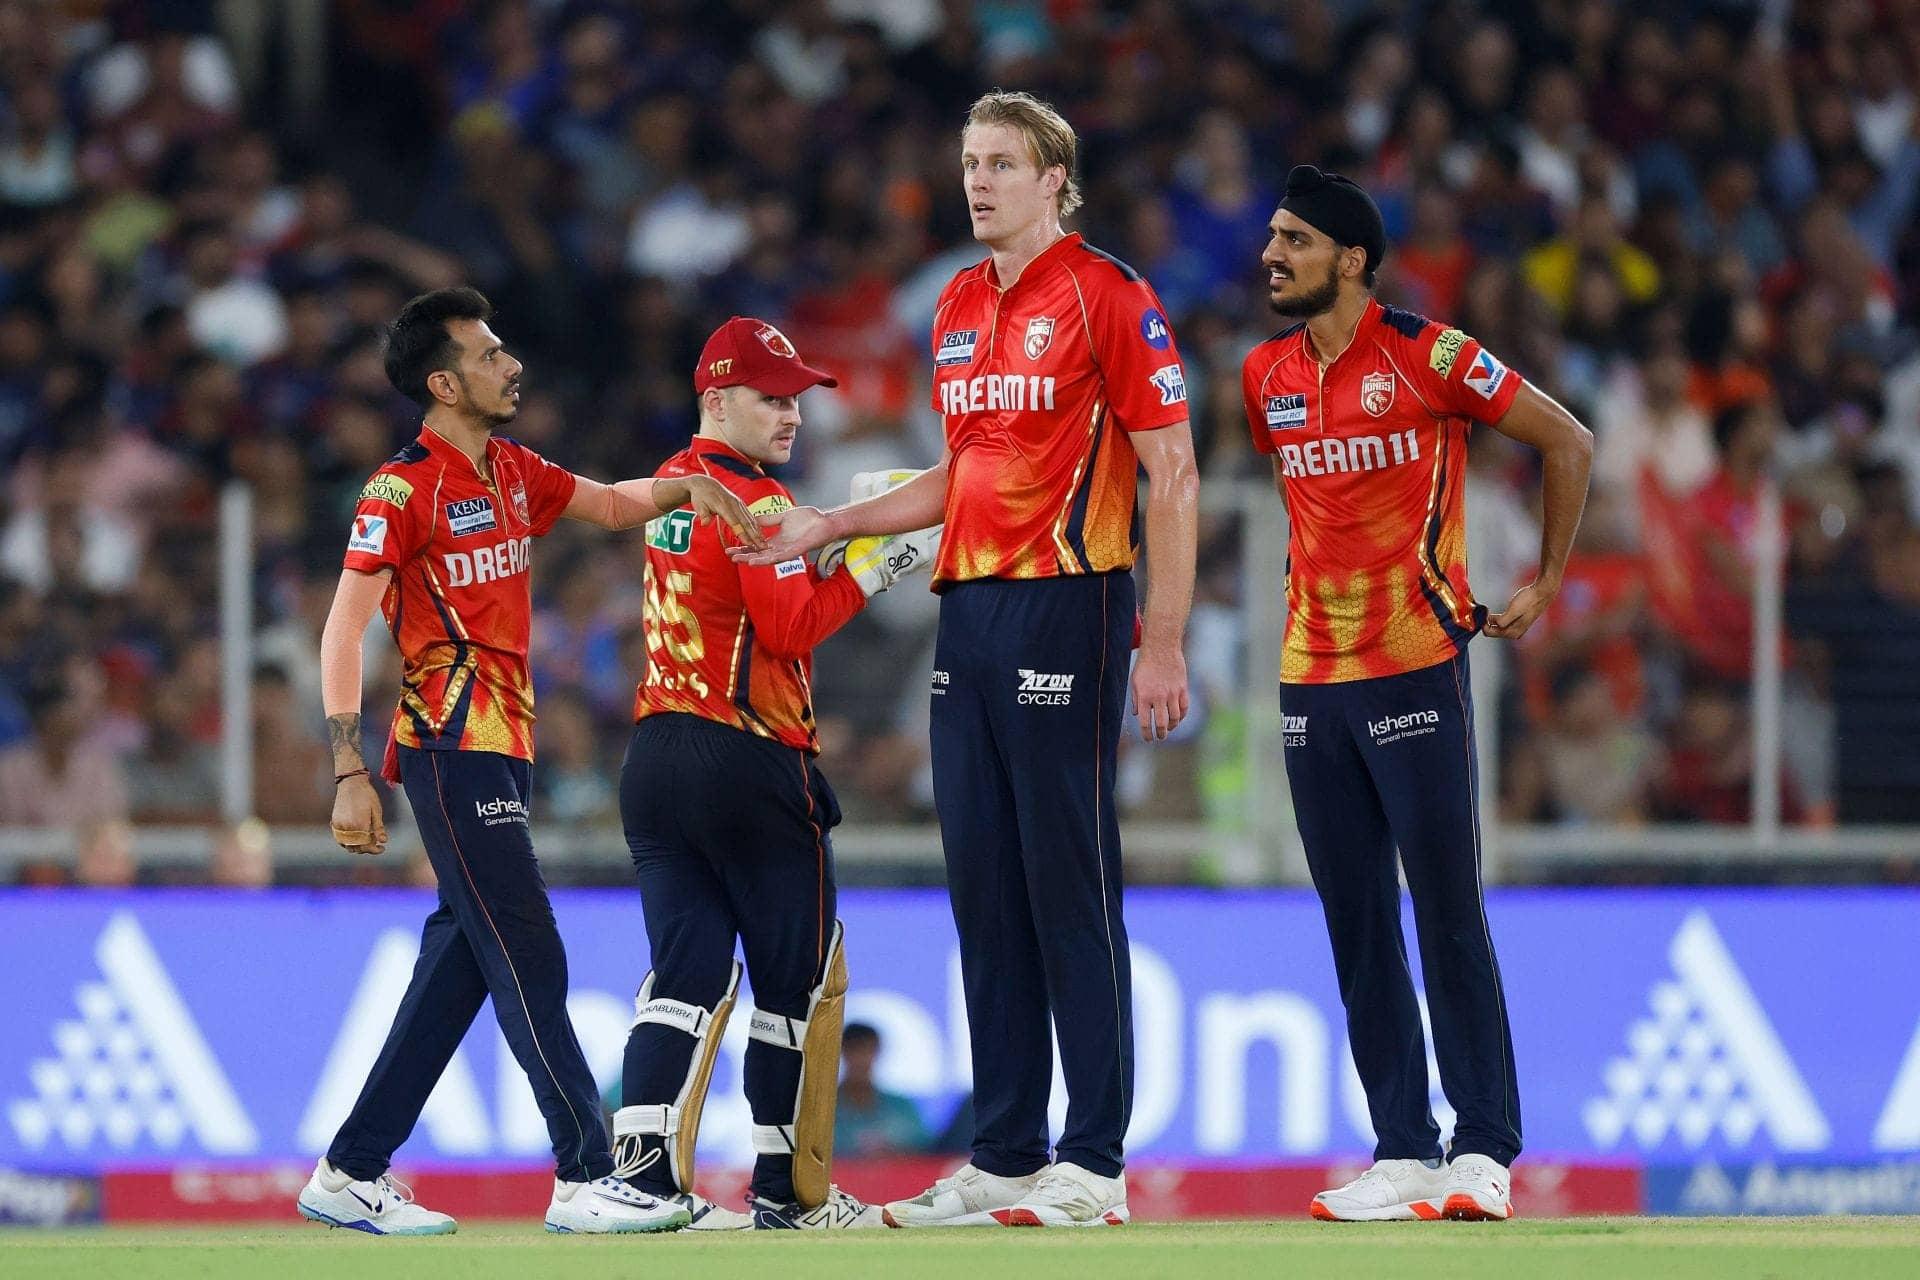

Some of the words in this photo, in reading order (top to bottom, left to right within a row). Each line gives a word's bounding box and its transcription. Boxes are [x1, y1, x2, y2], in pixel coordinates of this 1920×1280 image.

[942, 332, 972, 346] KENT
[709, 358, 733, 378] 167
[1364, 381, 1392, 394] KINGS
[443, 536, 531, 588] DREAM
[1018, 669, 1075, 692] AVON
[1017, 693, 1071, 706] CYCLES
[1367, 709, 1440, 738] kshema
[1376, 732, 1401, 746] General
[1401, 726, 1436, 739] Insurance
